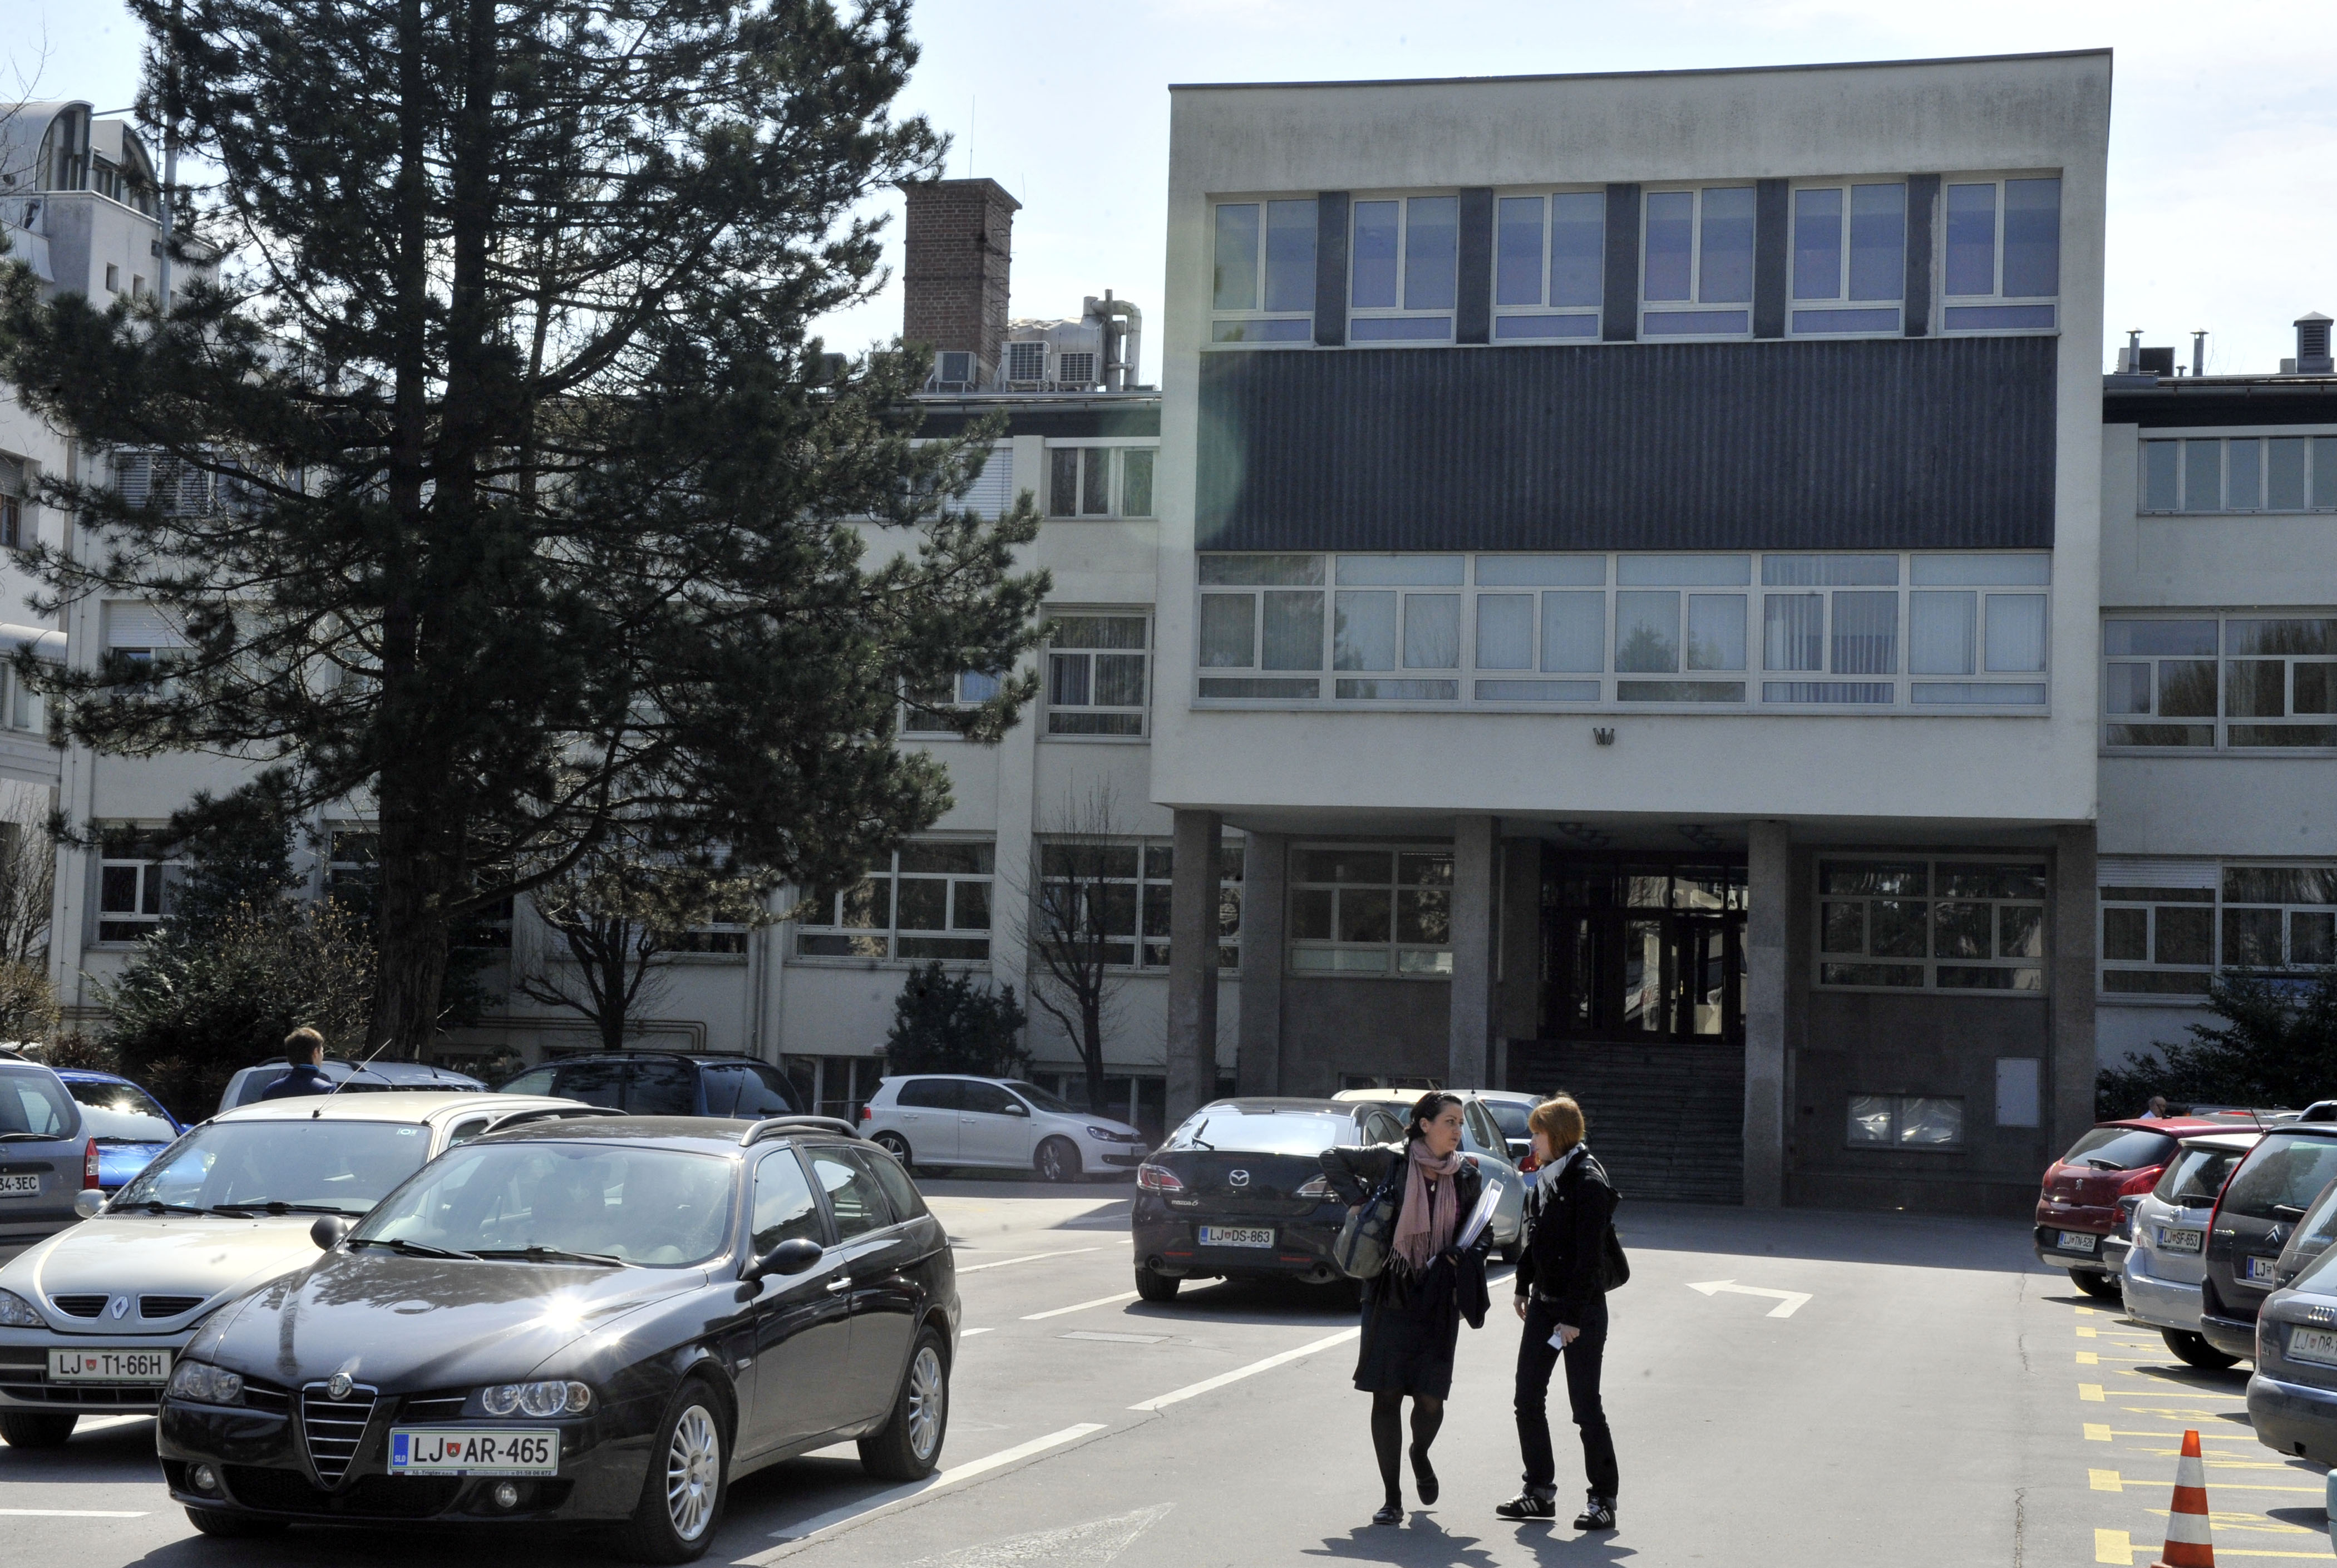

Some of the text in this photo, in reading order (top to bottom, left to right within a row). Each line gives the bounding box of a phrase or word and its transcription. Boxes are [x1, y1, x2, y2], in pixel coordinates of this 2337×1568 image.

[1210, 1229, 1270, 1242] LJ DS-863
[2164, 1230, 2197, 1247] LJ SF-653
[2255, 1261, 2265, 1276] LJ
[2294, 1332, 2337, 1355] LJ D8-
[60, 1354, 161, 1375] LJ T1-66H
[414, 1437, 548, 1463] LJ AR-465
